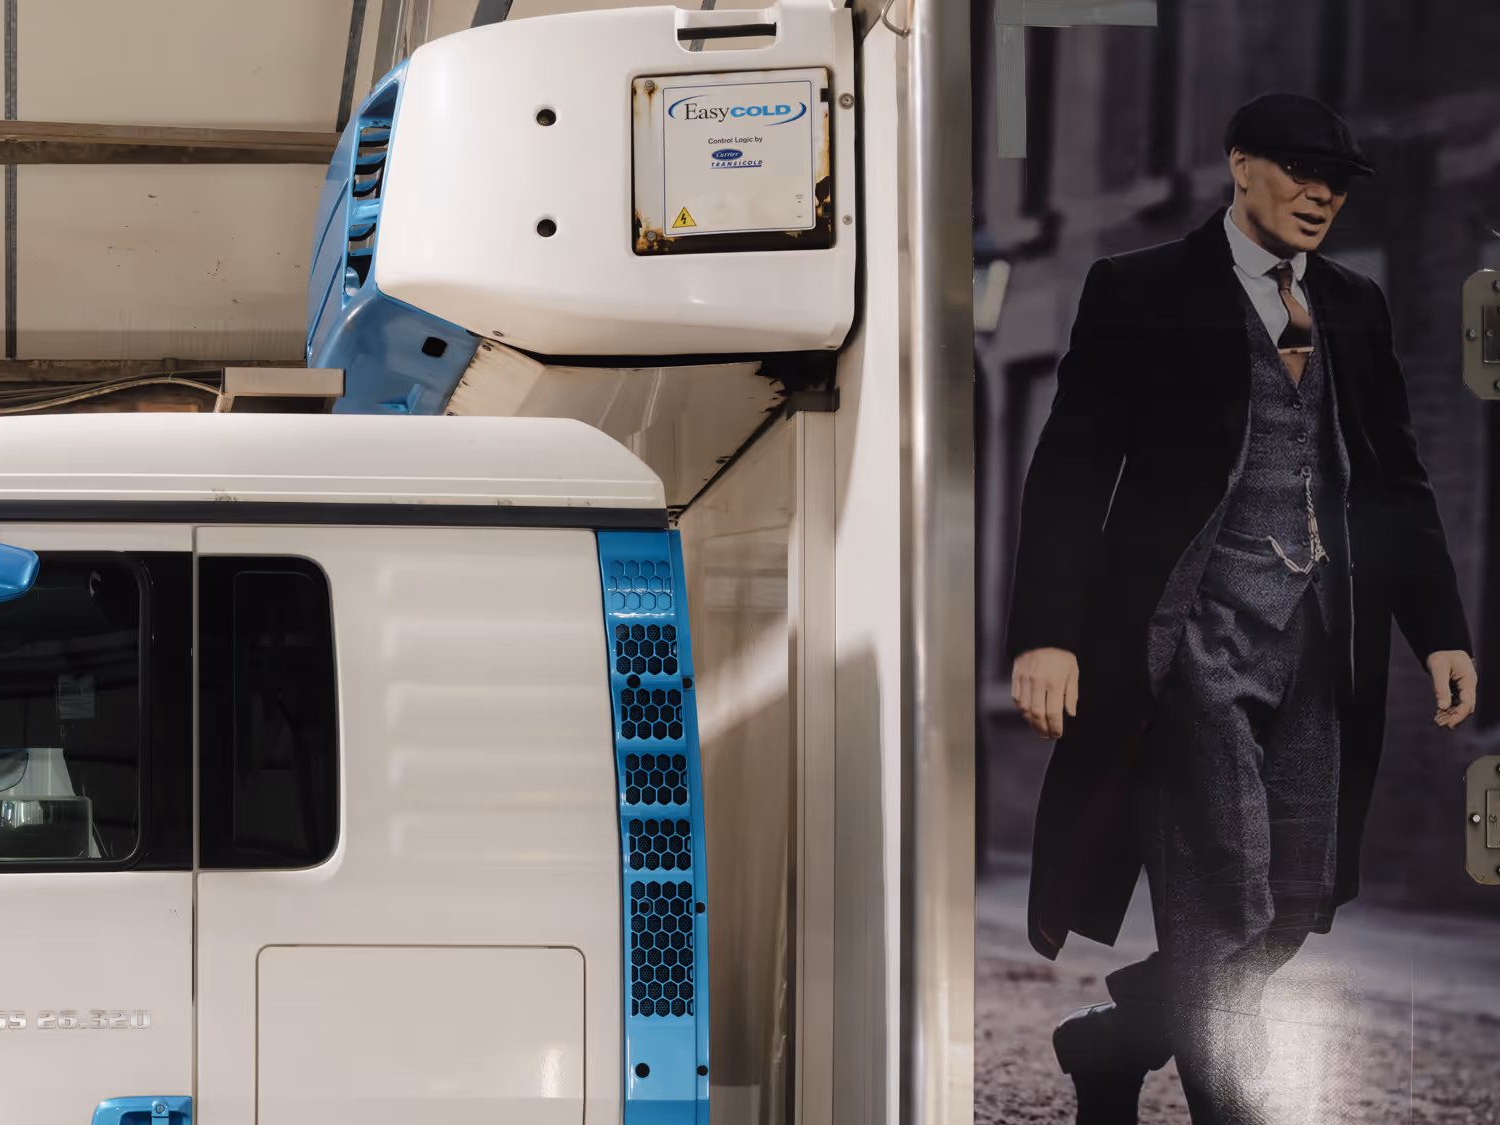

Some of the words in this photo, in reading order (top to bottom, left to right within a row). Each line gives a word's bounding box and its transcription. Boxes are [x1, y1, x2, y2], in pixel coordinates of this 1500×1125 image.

[684, 103, 791, 122] EasyCOLD
[707, 137, 733, 145] Control
[735, 136, 753, 144] Logic
[711, 160, 763, 168] TRANSICOLD
[36, 1009, 151, 1030] 26.320
